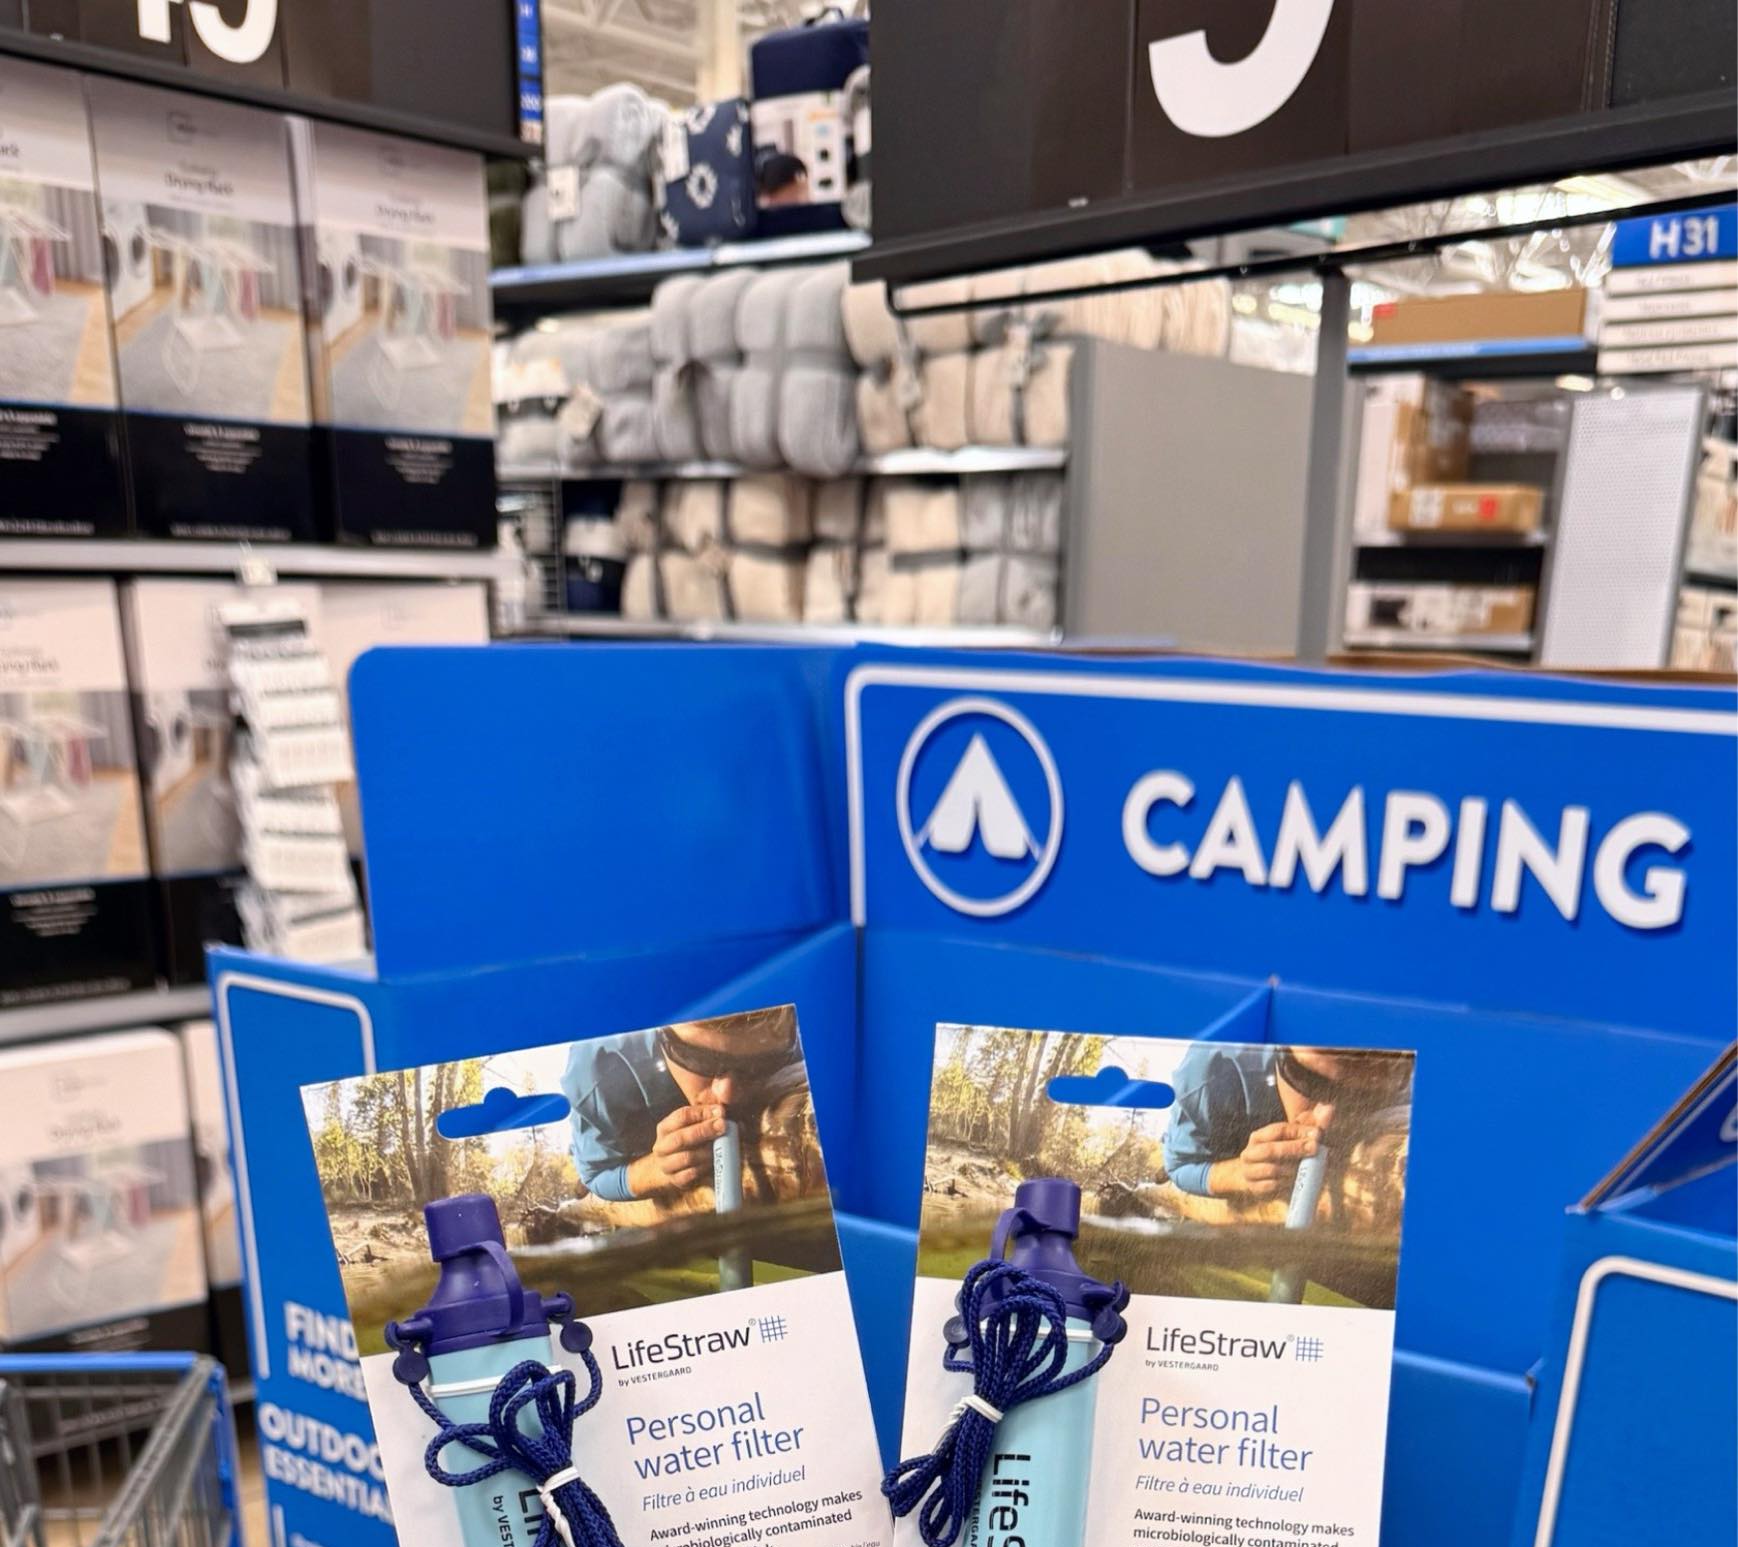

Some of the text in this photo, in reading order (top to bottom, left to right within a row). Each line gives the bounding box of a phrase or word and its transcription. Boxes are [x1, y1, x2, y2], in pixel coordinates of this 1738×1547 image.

[1649, 214, 1719, 259] H31
[1122, 769, 1692, 929] CAMPING
[283, 1300, 360, 1361] FIND
[625, 1390, 765, 1445] Personal
[1140, 1396, 1278, 1434] Personal
[633, 1427, 804, 1479] water filter
[1138, 1436, 1313, 1471] water filter
[263, 1444, 395, 1526] ESSENTIA
[492, 1495, 505, 1513] by
[642, 1464, 805, 1511] Filtre à eau individuel
[1134, 1474, 1304, 1502] Filtre à eau individuel
[649, 1490, 863, 1541] Award-winning technology makes
[764, 1507, 852, 1537] contaminated
[1133, 1507, 1355, 1537] Award-winning technology makes
